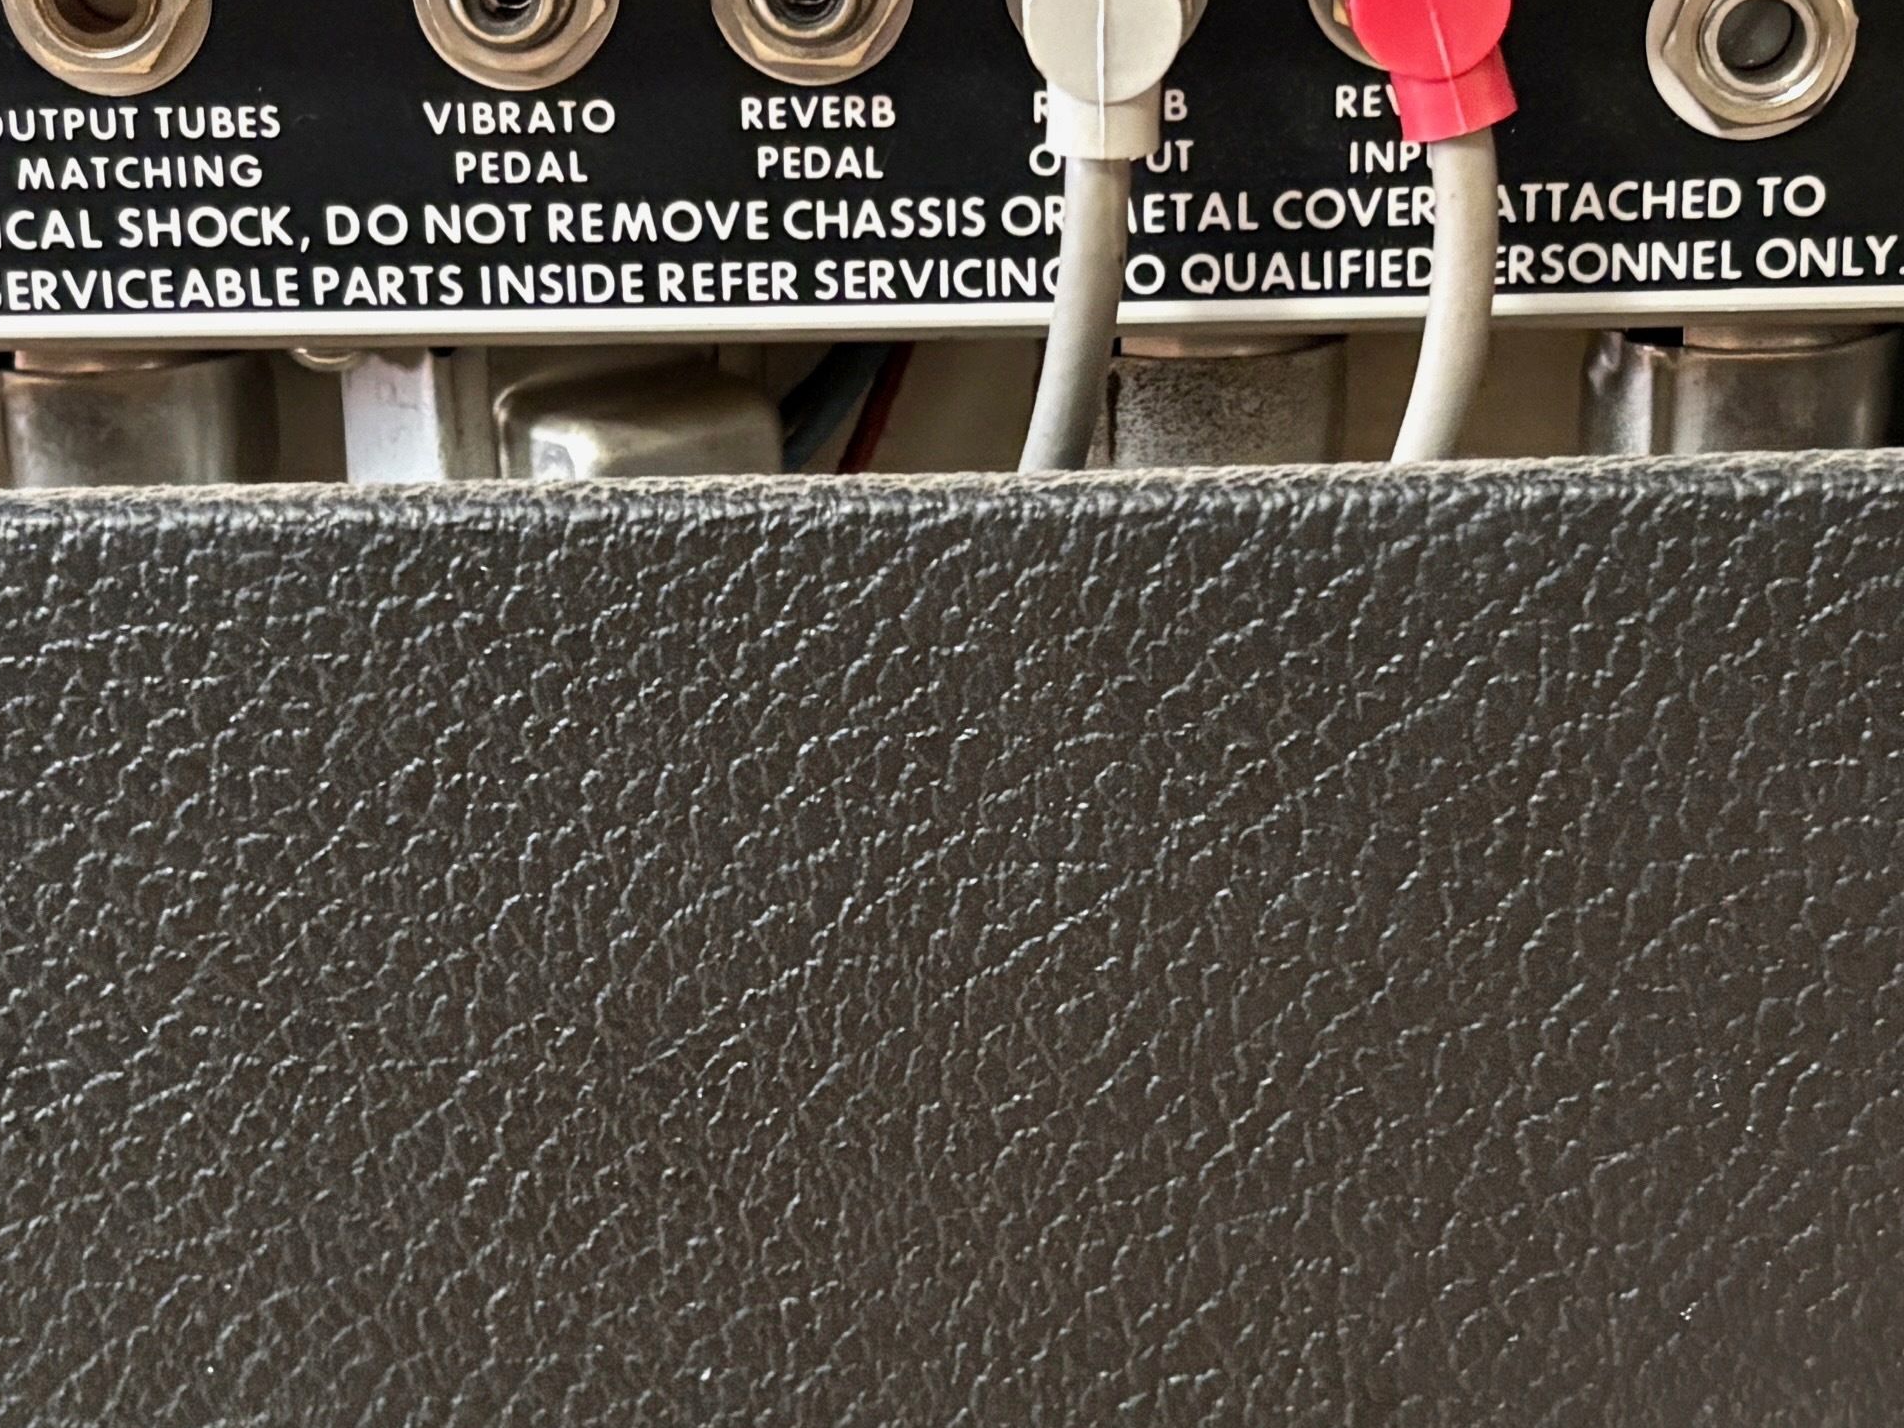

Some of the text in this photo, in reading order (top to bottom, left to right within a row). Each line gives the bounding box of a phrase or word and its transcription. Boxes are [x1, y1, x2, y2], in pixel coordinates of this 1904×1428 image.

[154, 105, 280, 138] TUBES
[423, 99, 615, 134] VIBRATO
[741, 95, 895, 129] REVERB
[18, 154, 262, 190] MATCHING
[456, 151, 587, 183] PEDAL
[758, 146, 883, 178] PEDAL
[1029, 140, 1193, 176] OUT
[1350, 139, 1433, 173] INP
[118, 206, 309, 252] SHOCK,
[326, 204, 408, 245] DO
[424, 203, 531, 244] NOT
[548, 200, 769, 242] REMOVE
[783, 197, 985, 239] CHASSIS
[1001, 194, 1065, 236] OR
[1497, 178, 1741, 222] ATTACHED
[1761, 175, 1826, 216] TO
[313, 265, 463, 305] PARTS
[481, 264, 643, 304] INSIDE
[659, 261, 798, 302] REFER
[1125, 254, 1165, 294] O
[1181, 247, 1433, 294] QUALIFIED
[1494, 240, 1742, 284] ERSONNEL
